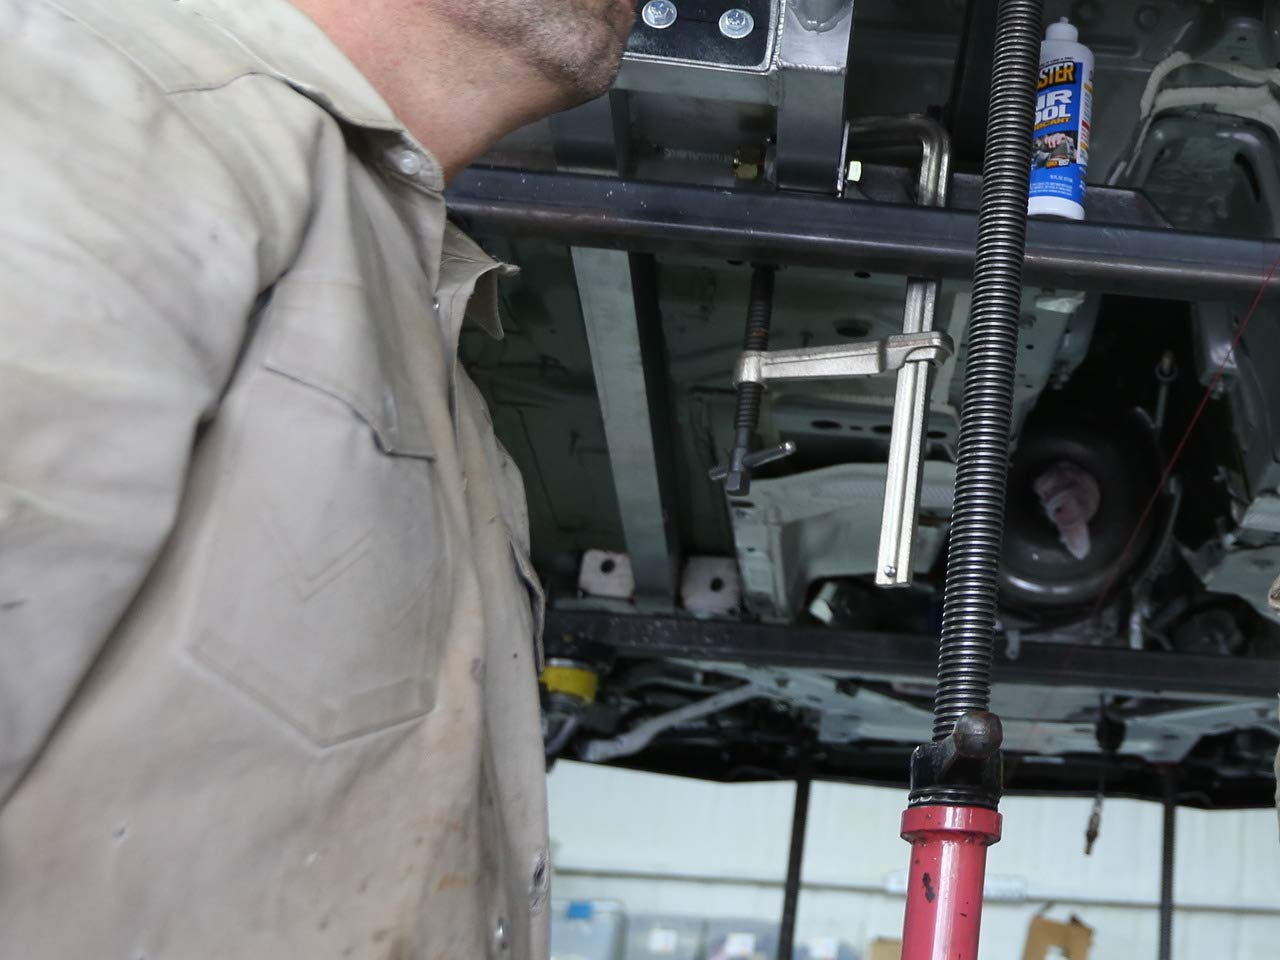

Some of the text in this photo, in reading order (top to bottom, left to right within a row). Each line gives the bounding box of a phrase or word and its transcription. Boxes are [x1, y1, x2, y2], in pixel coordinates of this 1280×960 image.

[1037, 61, 1075, 89] STER
[1036, 89, 1073, 111] IR
[1035, 104, 1072, 126] OL
